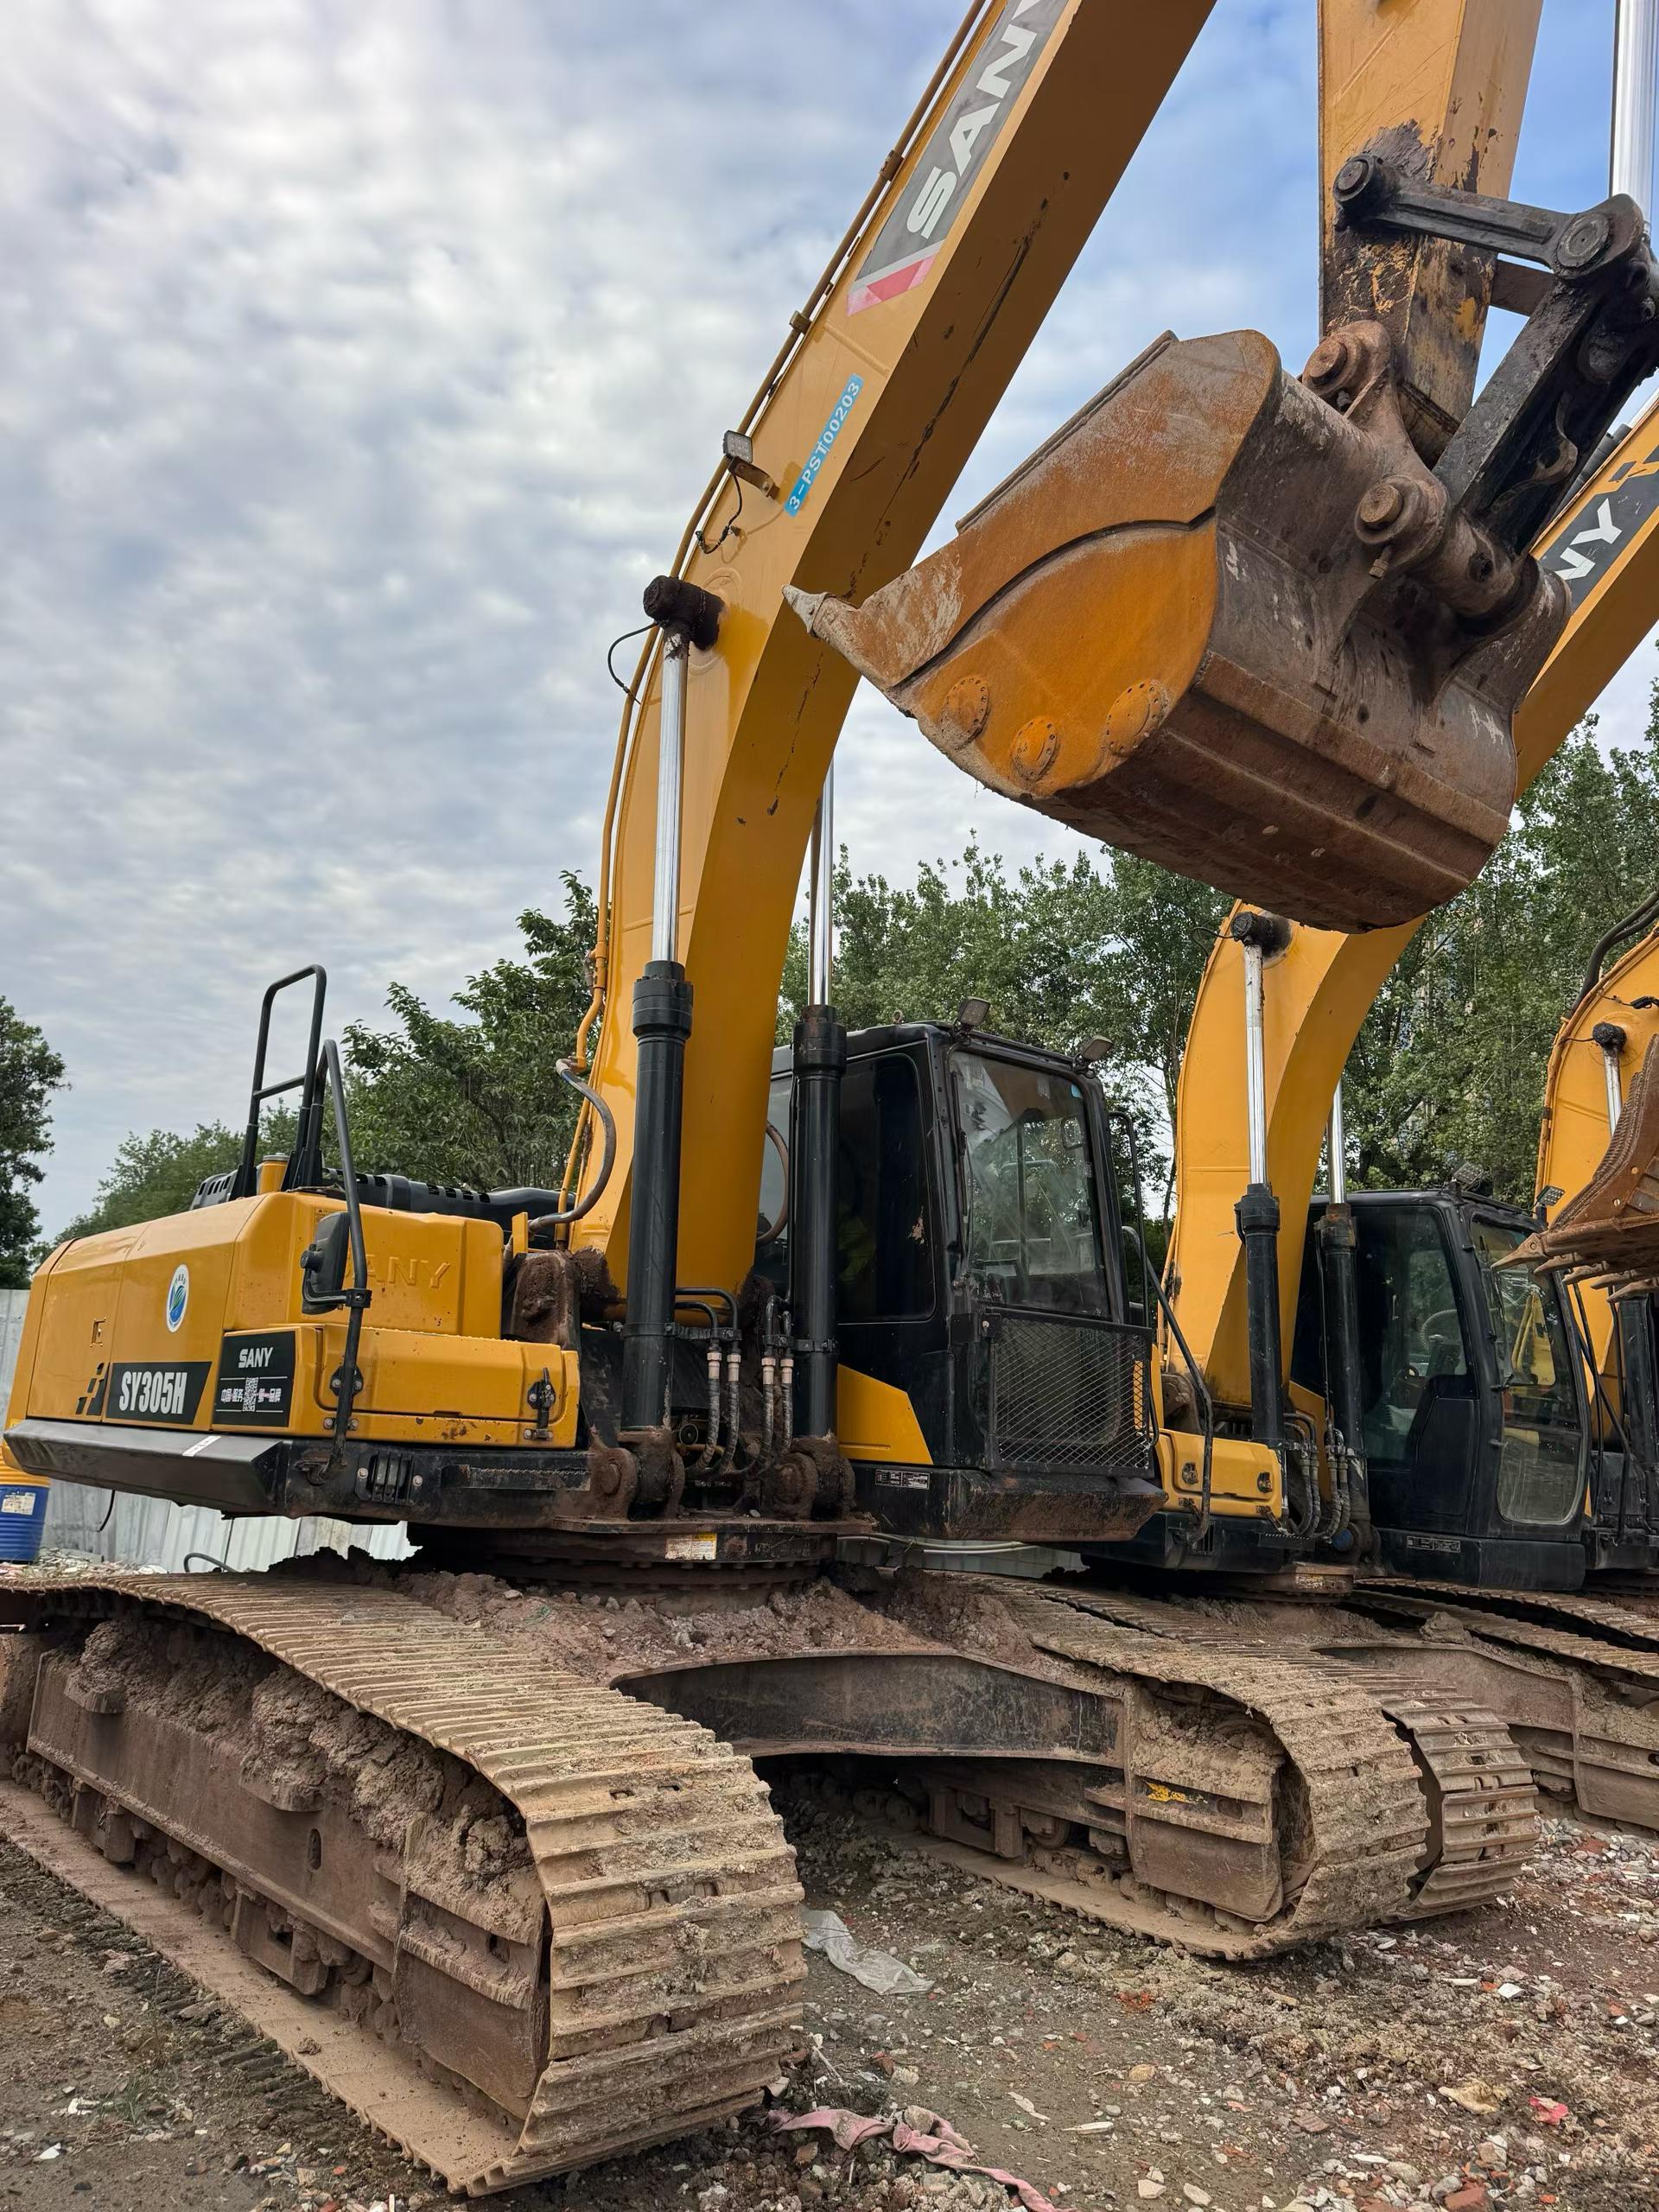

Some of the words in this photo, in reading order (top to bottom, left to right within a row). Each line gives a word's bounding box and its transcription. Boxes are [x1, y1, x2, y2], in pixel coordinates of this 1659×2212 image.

[346, 1253, 451, 1289] ANY
[238, 1347, 274, 1369] SANY
[118, 1370, 188, 1414] SY305H
